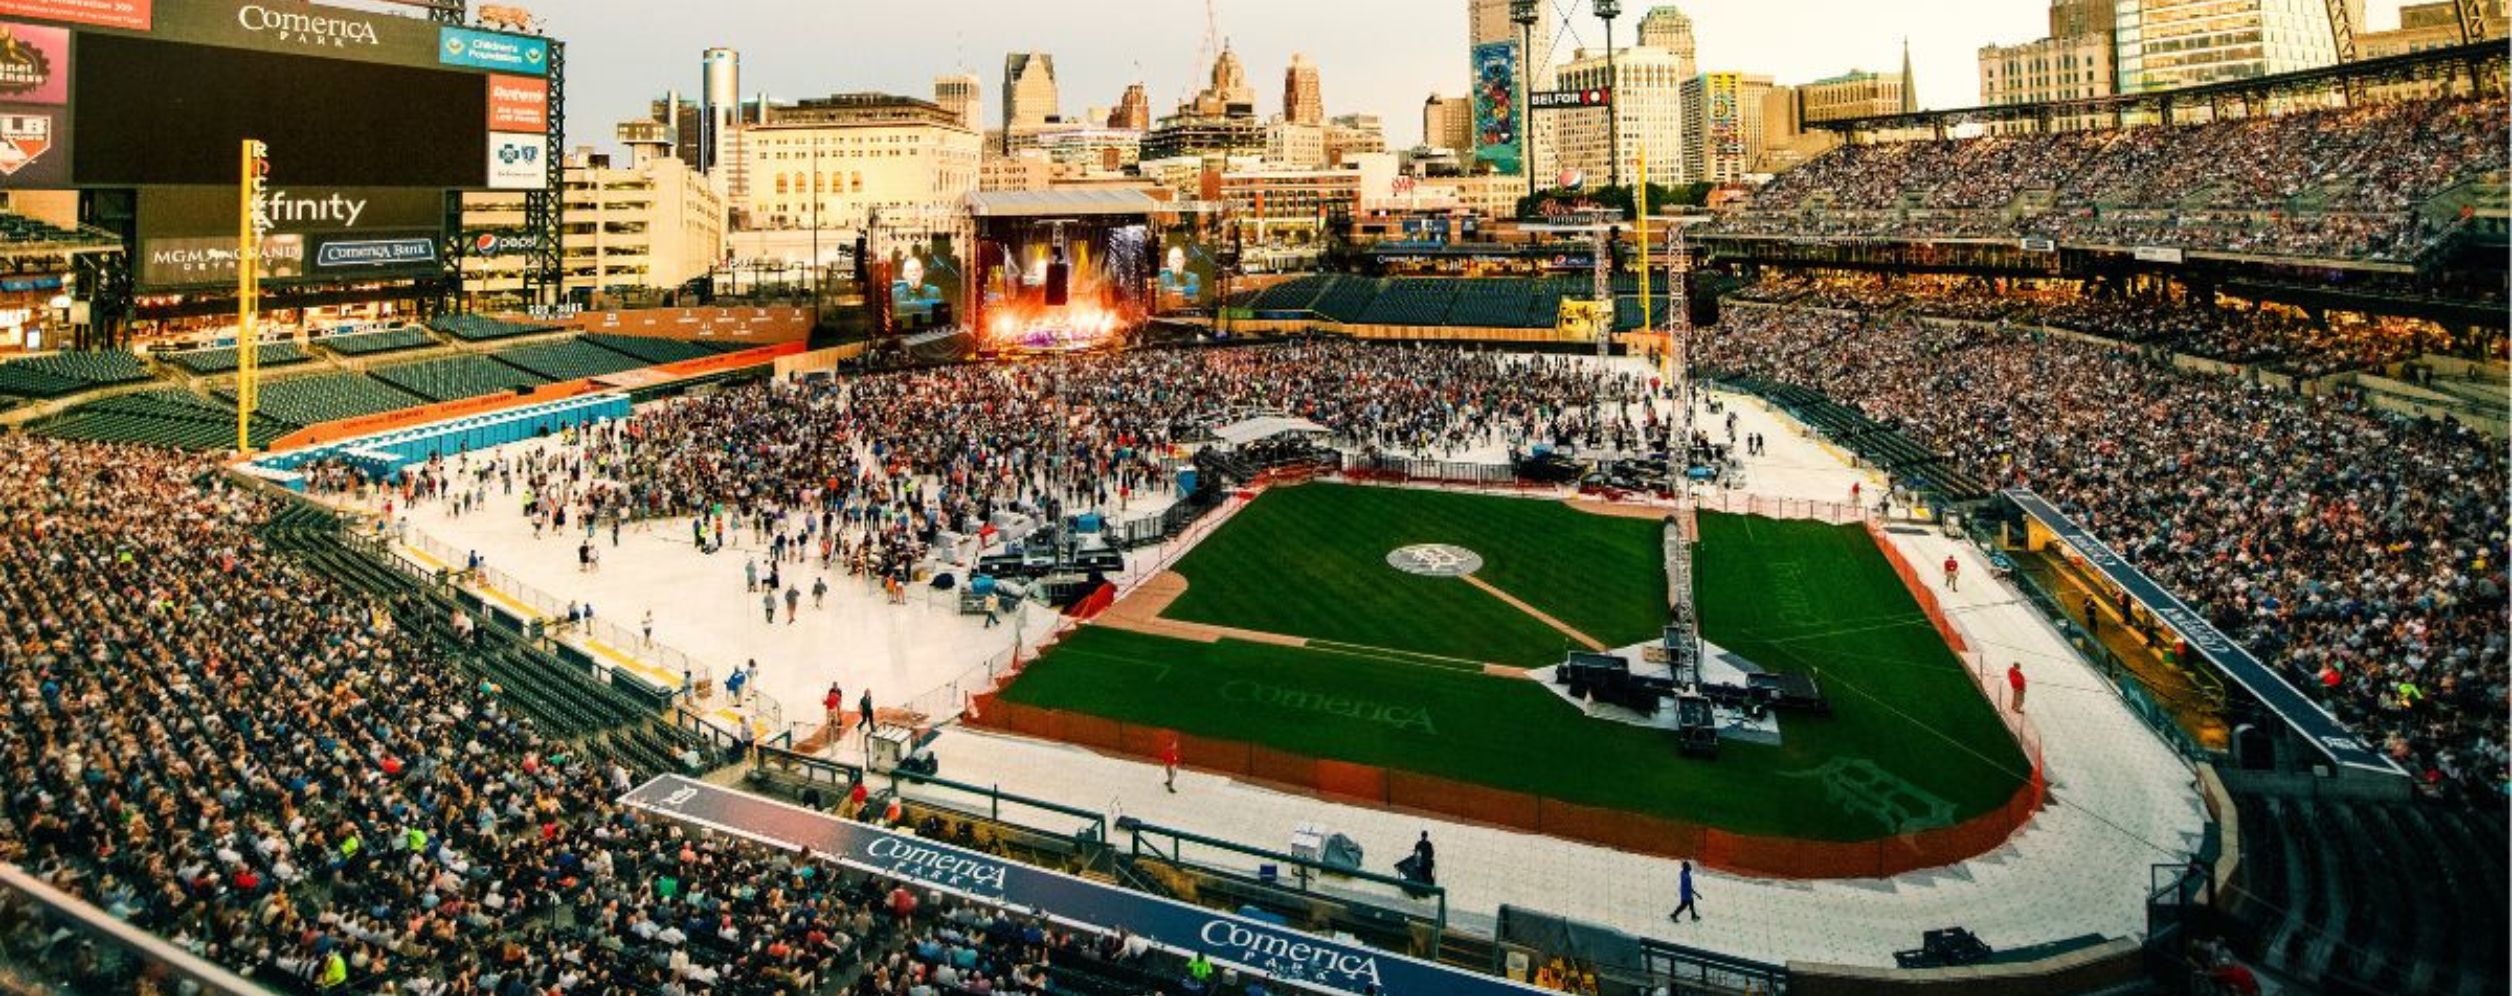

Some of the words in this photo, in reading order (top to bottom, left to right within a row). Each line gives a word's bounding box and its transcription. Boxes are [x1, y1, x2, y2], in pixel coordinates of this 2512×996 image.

[279, 31, 344, 48] PARK
[1532, 93, 1580, 105] BELFOR
[153, 249, 204, 264] MGM
[393, 243, 426, 258] Bank
[184, 259, 272, 271] DETRT
